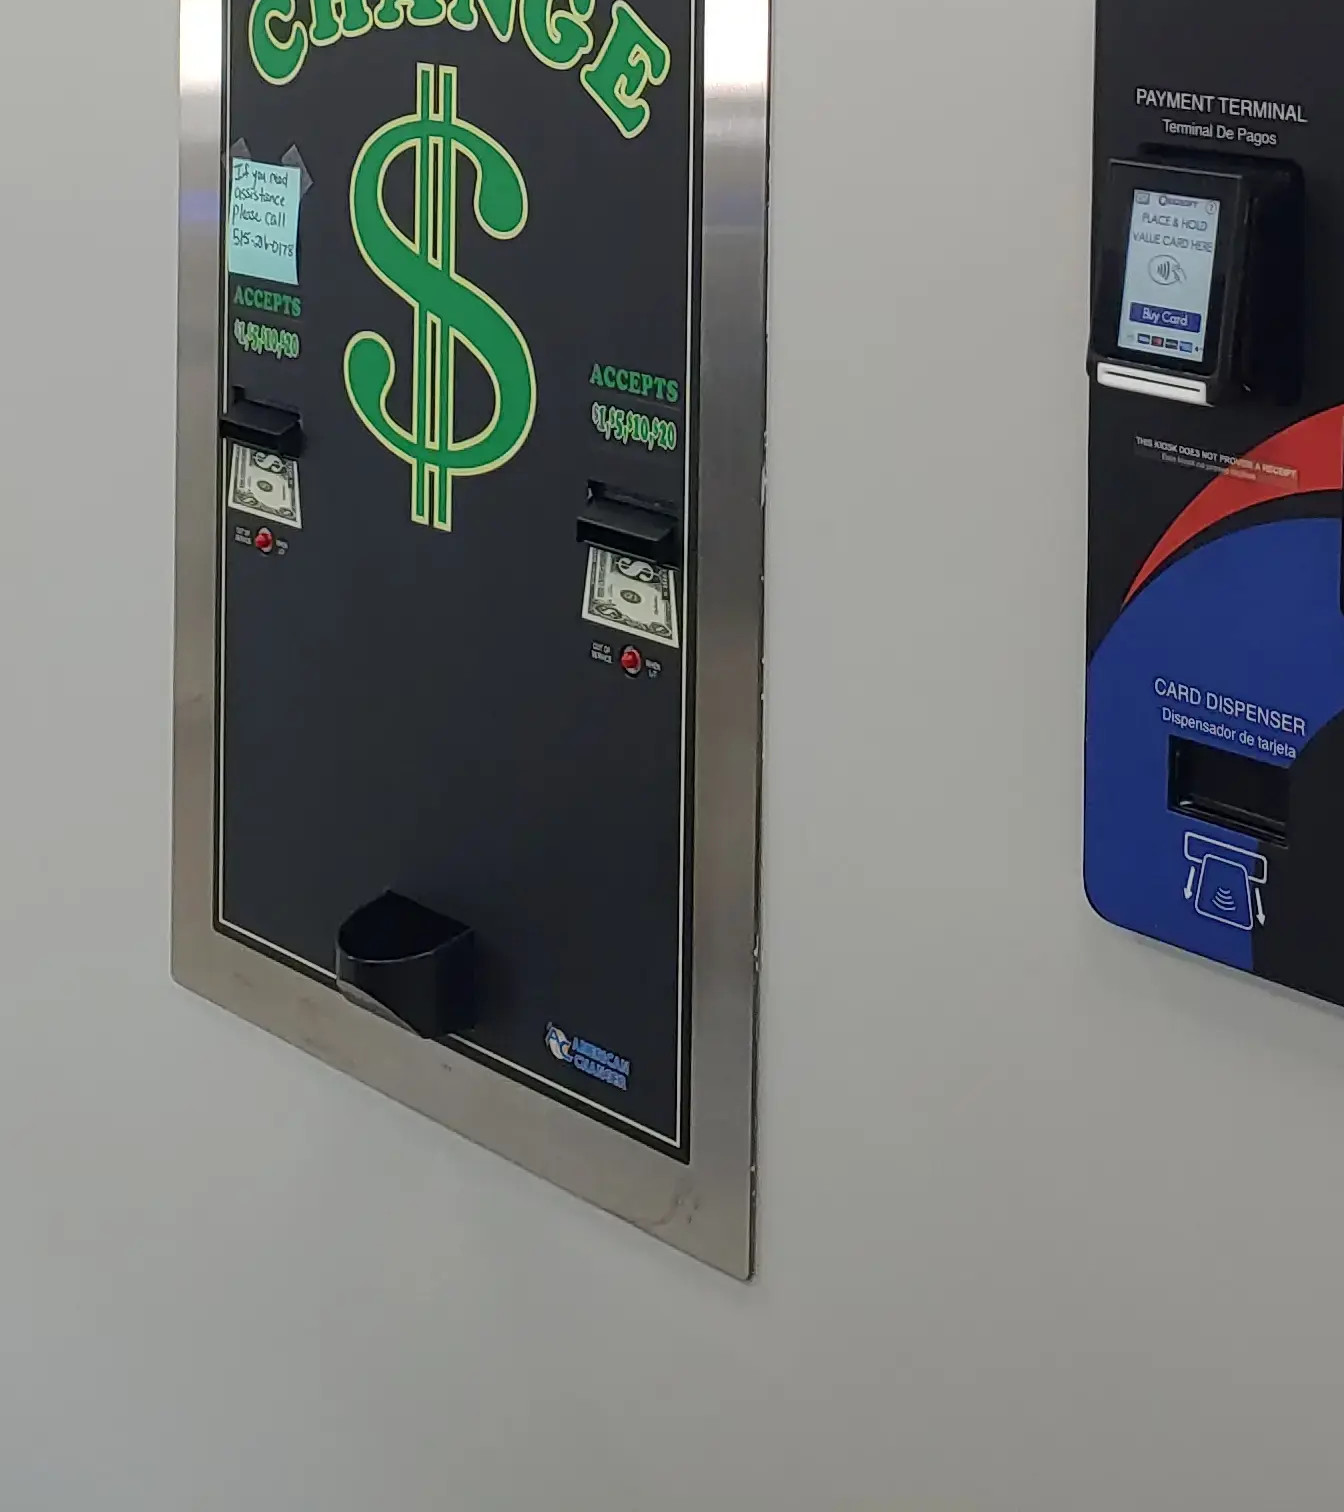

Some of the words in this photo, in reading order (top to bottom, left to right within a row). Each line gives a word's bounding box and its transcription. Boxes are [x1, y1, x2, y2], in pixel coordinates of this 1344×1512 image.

[1136, 88, 1215, 113] PAYMENT
[1219, 97, 1308, 122] TERMINAL
[1162, 119, 1213, 138] Terminal
[1216, 125, 1235, 139] De
[1238, 129, 1277, 146] Pagos
[1142, 212, 1171, 227] PLACE
[1182, 220, 1207, 231] HOLD
[1133, 231, 1160, 244] VALUE
[1162, 236, 1189, 248] CARD
[1191, 240, 1212, 252] HERE
[234, 284, 301, 316] ACCEPTS
[1143, 308, 1160, 323] Buy
[1162, 312, 1188, 327] Card
[590, 363, 678, 403] ACCEPTS
[1136, 436, 1152, 447] THIS
[1155, 441, 1177, 452] KIOSK
[1179, 446, 1200, 458] DOES
[1202, 451, 1217, 462] NOT
[1256, 462, 1261, 470] A
[1262, 464, 1297, 479] RECEIPT
[1154, 678, 1202, 704] CARD
[1206, 692, 1305, 736] DISPENSER
[1162, 707, 1236, 740] Dispensador
[1238, 730, 1254, 746] de
[1257, 735, 1296, 758] tarjeta
